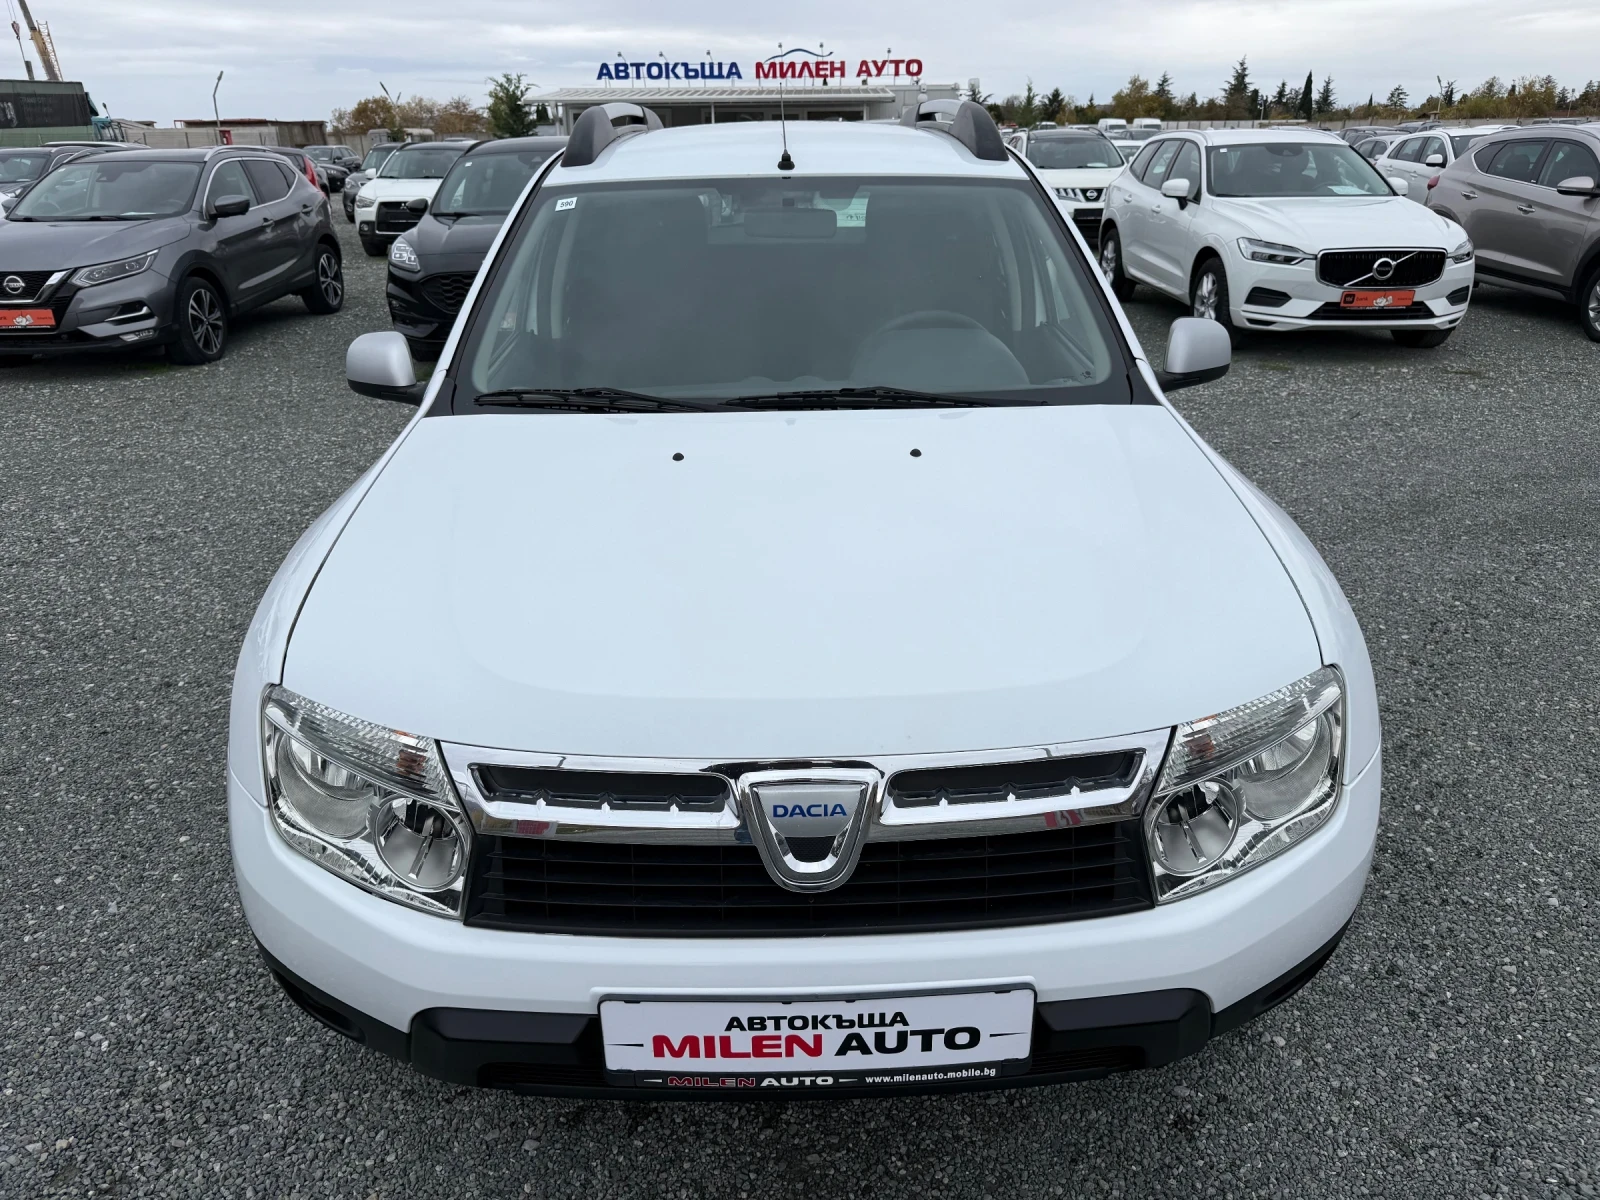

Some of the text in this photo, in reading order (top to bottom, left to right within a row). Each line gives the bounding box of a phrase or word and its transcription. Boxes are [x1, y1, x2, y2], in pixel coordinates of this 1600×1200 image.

[596, 58, 923, 80] АВТОКЪЩА МИЛЕН АУТО
[560, 200, 574, 208] 590
[772, 803, 848, 818] DACIA
[724, 1011, 910, 1032] АВТОКЪЩА
[652, 1026, 981, 1059] MILEN AUTO
[667, 1067, 997, 1088] MILEN AUTO www.milenauto.mobile.bg
